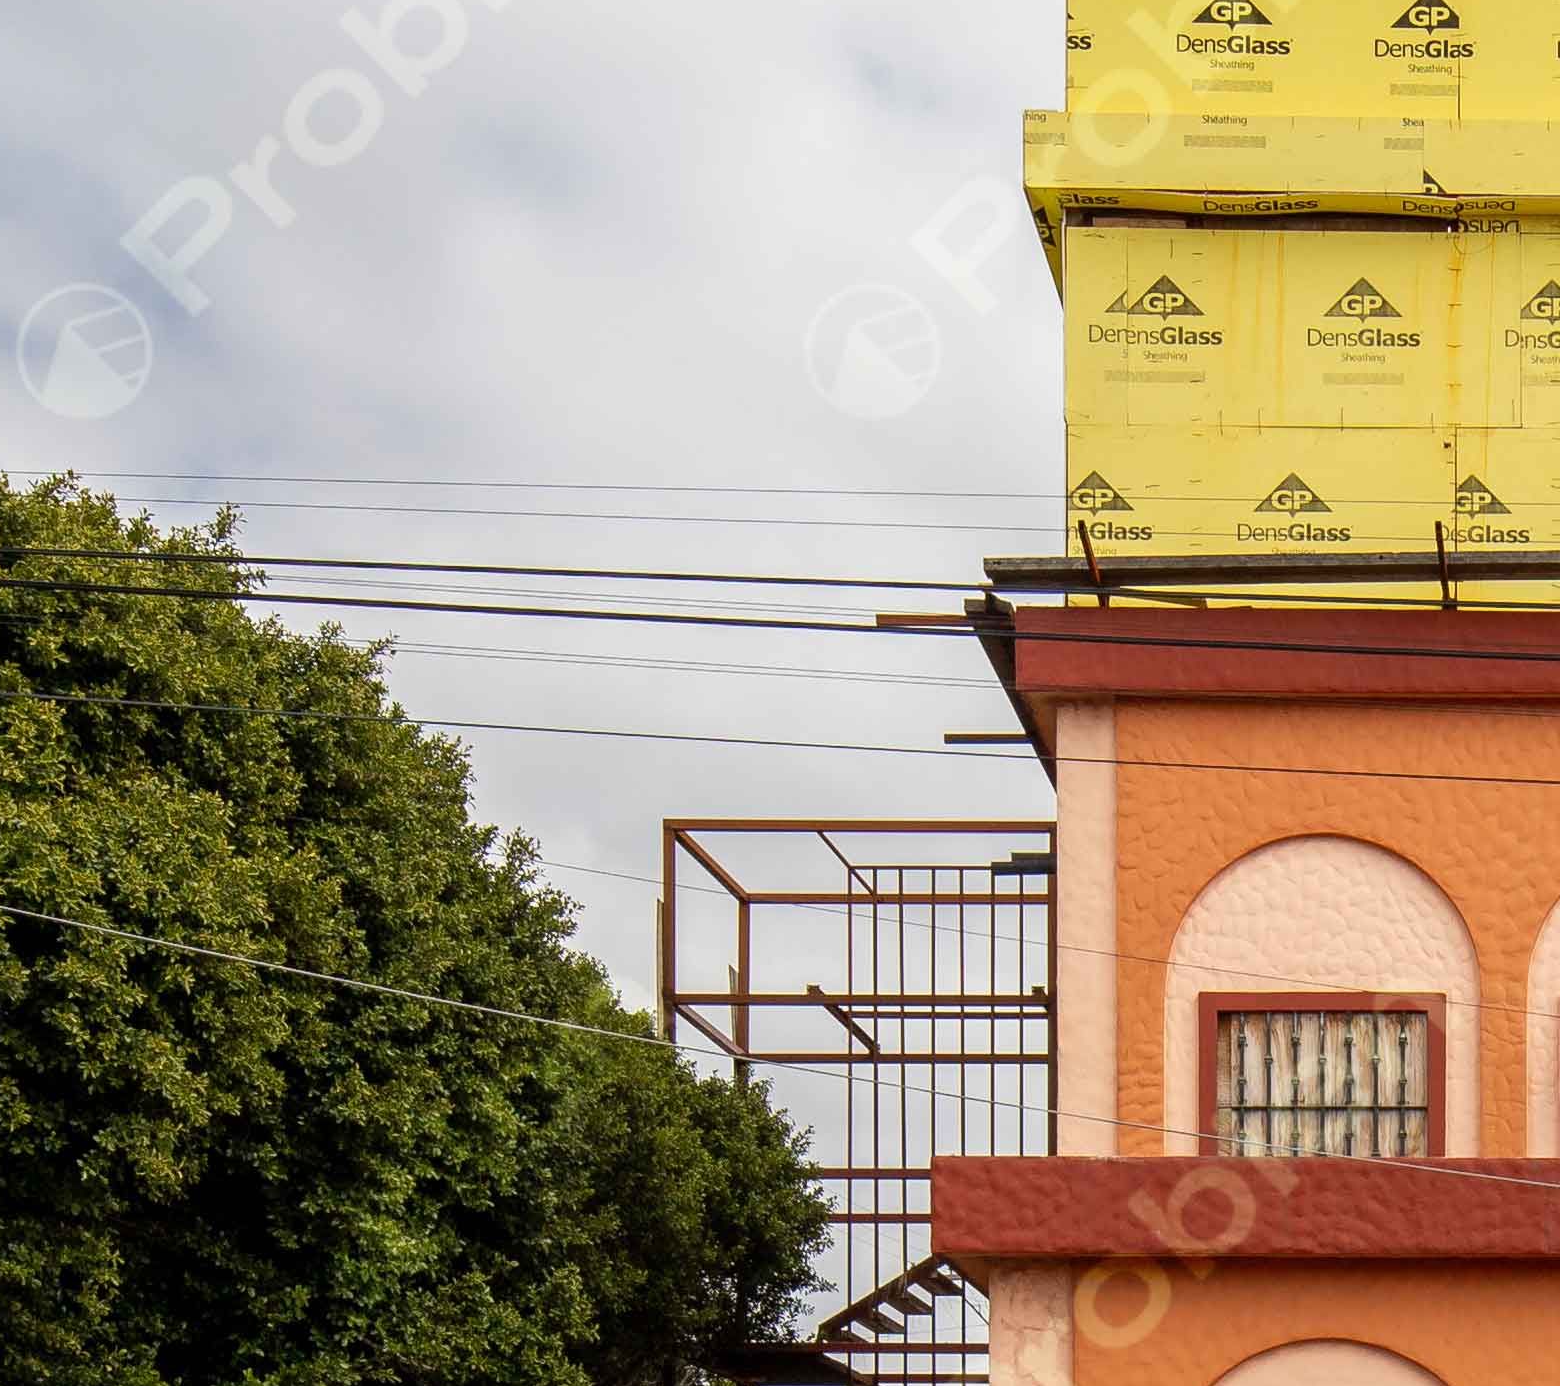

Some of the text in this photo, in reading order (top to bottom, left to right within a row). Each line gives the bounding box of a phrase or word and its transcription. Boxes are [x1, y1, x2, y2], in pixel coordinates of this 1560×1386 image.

[1210, 1, 1252, 22] GP
[1408, 6, 1450, 26] GP
[1176, 33, 1290, 57] DensGlass
[1209, 58, 1255, 72] Sheathing
[1407, 63, 1453, 75] Sheathing
[1202, 114, 1248, 126] Sheathing
[1203, 197, 1319, 213] DensGlass
[1143, 292, 1185, 313] GP
[1340, 295, 1383, 315] GP
[1307, 327, 1421, 349] DensGlass
[1143, 350, 1187, 362] Sheathing
[1341, 352, 1386, 364] Sheathing
[1073, 488, 1115, 510] GP
[1271, 489, 1313, 510] GP
[1237, 523, 1350, 543] DensGlass
